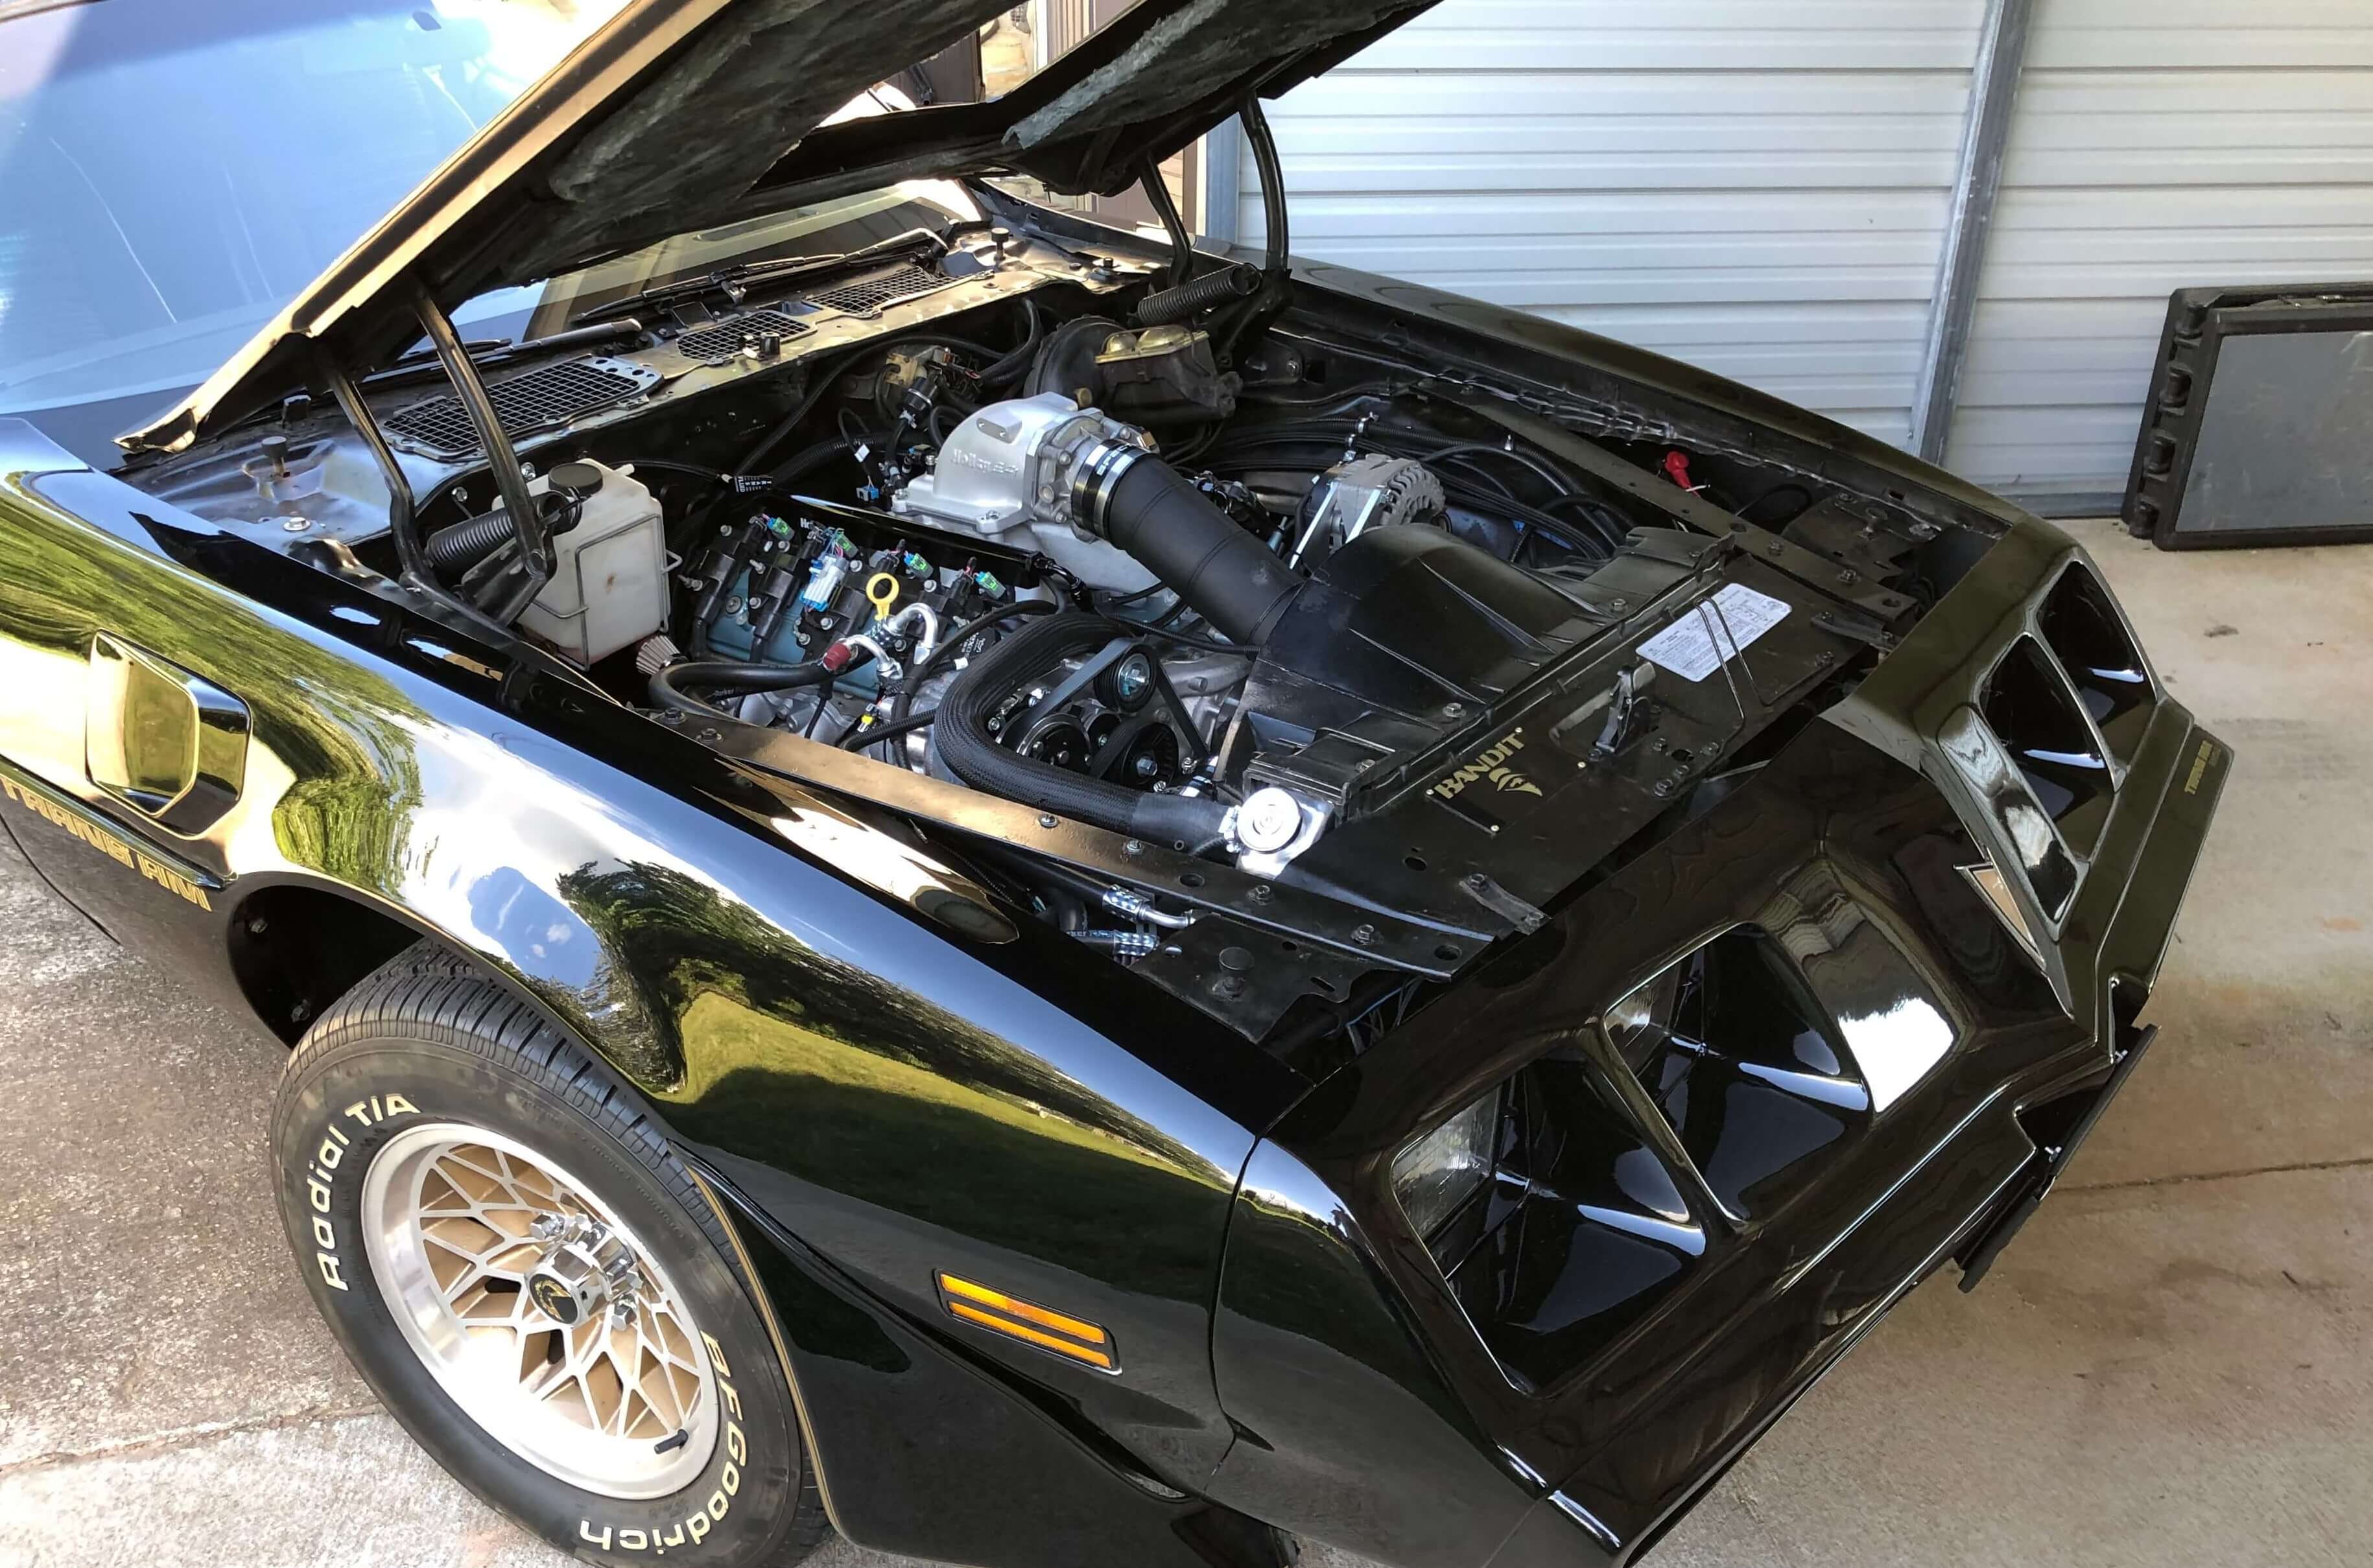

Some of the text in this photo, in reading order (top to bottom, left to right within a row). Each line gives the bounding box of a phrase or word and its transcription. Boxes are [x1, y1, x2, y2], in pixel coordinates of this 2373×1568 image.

[1434, 732, 1525, 799] BANDIT
[0, 777, 213, 913] TRANS AM
[306, 1123, 351, 1292] Radial
[579, 1329, 747, 1555] BFGoodrich
